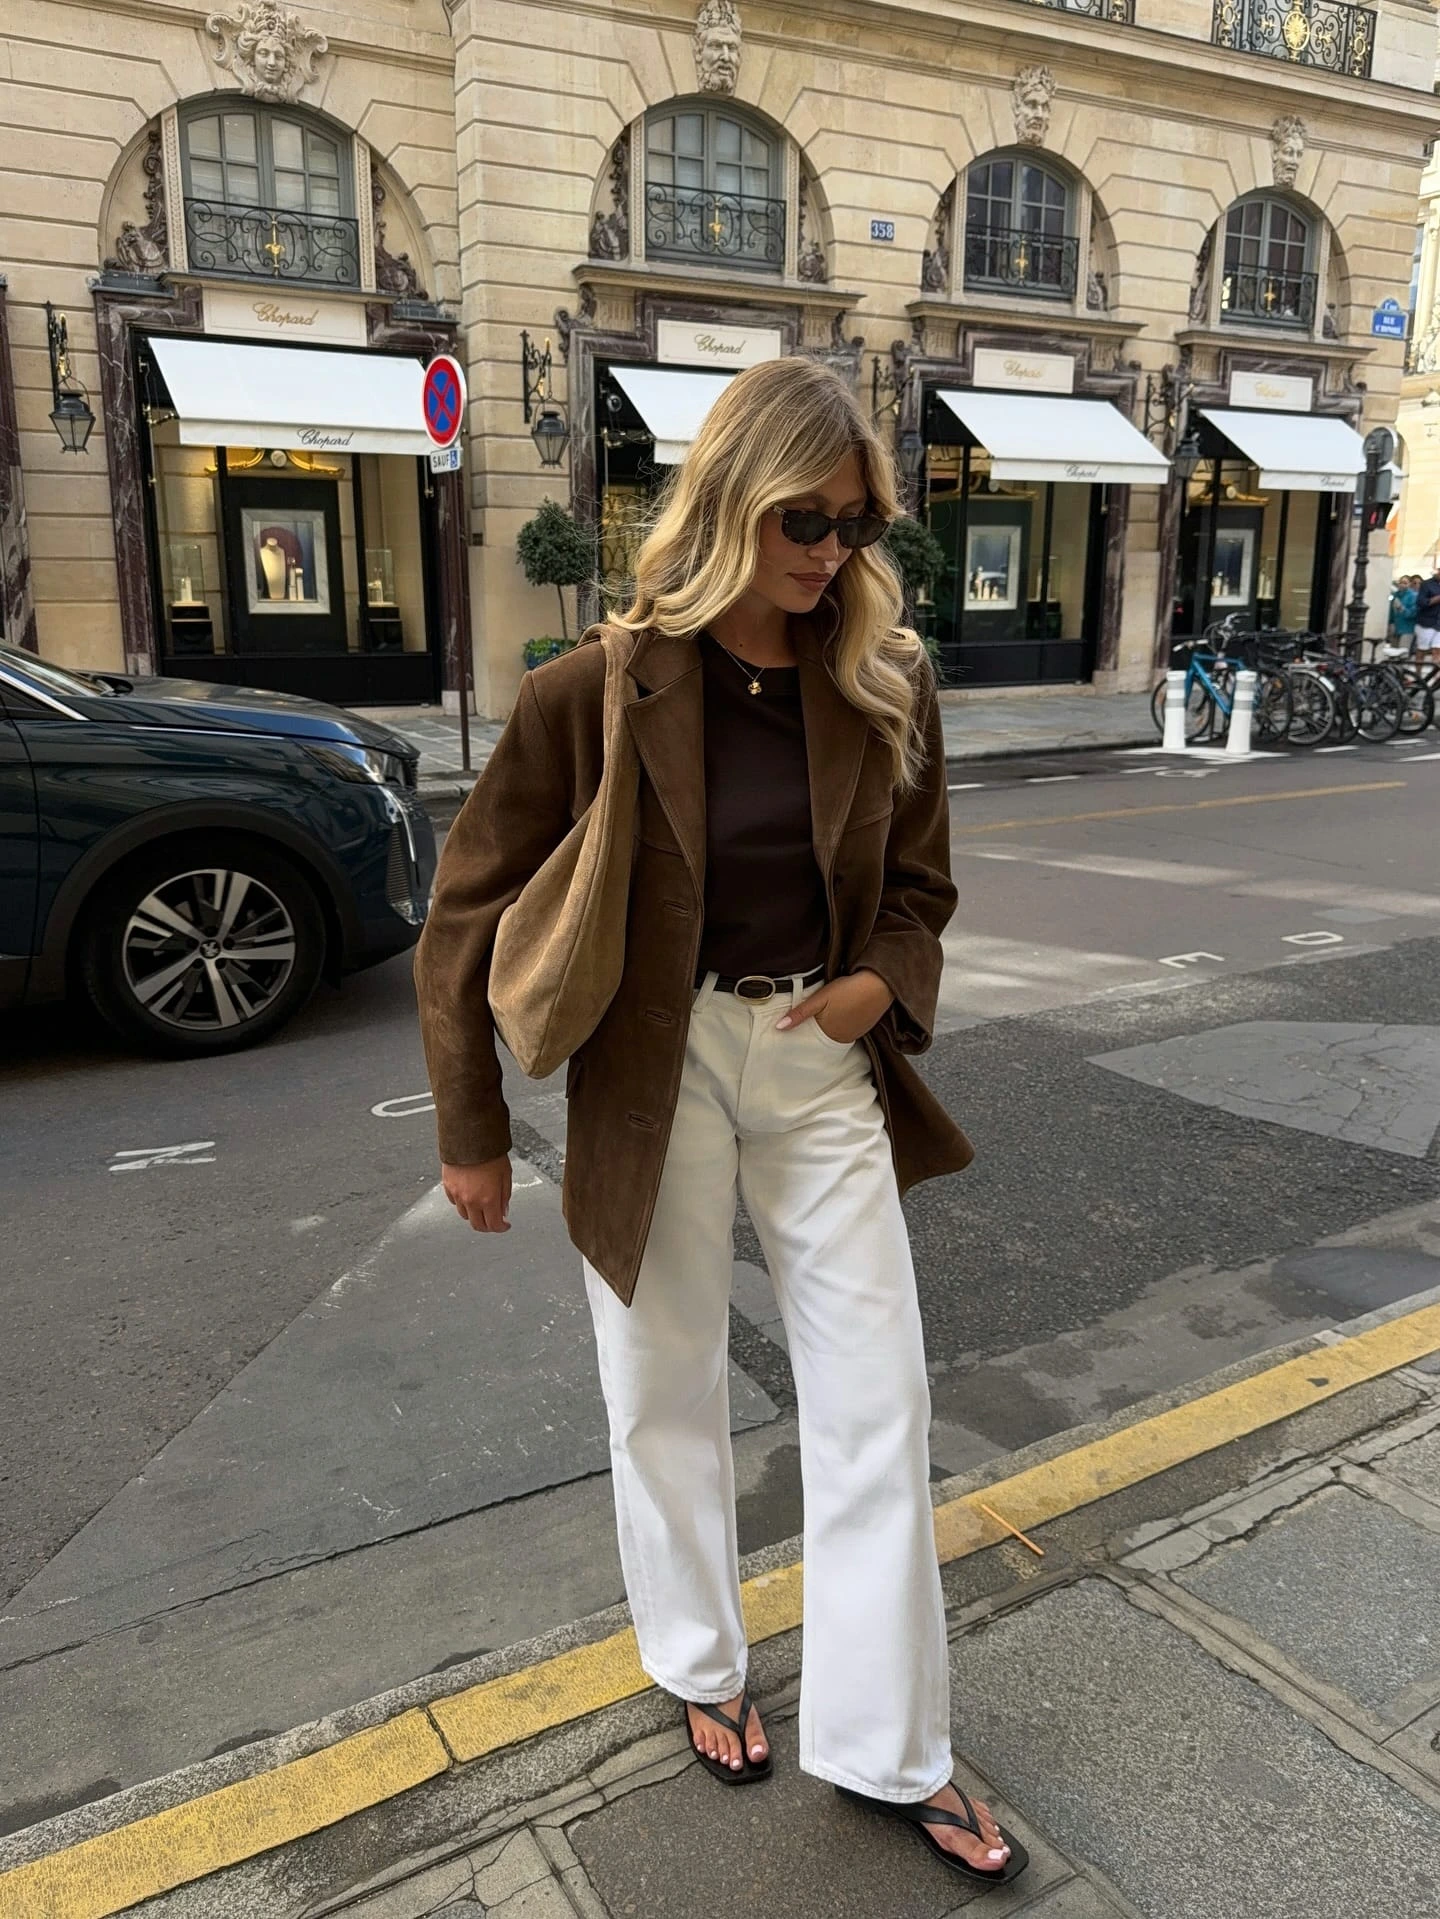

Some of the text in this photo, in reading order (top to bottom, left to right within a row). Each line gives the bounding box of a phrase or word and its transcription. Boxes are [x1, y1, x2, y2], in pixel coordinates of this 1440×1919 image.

[871, 222, 894, 239] 358
[252, 302, 320, 328] Chopard
[693, 333, 747, 357] Chopard
[297, 428, 355, 449] Chopard
[432, 453, 450, 469] SAUF
